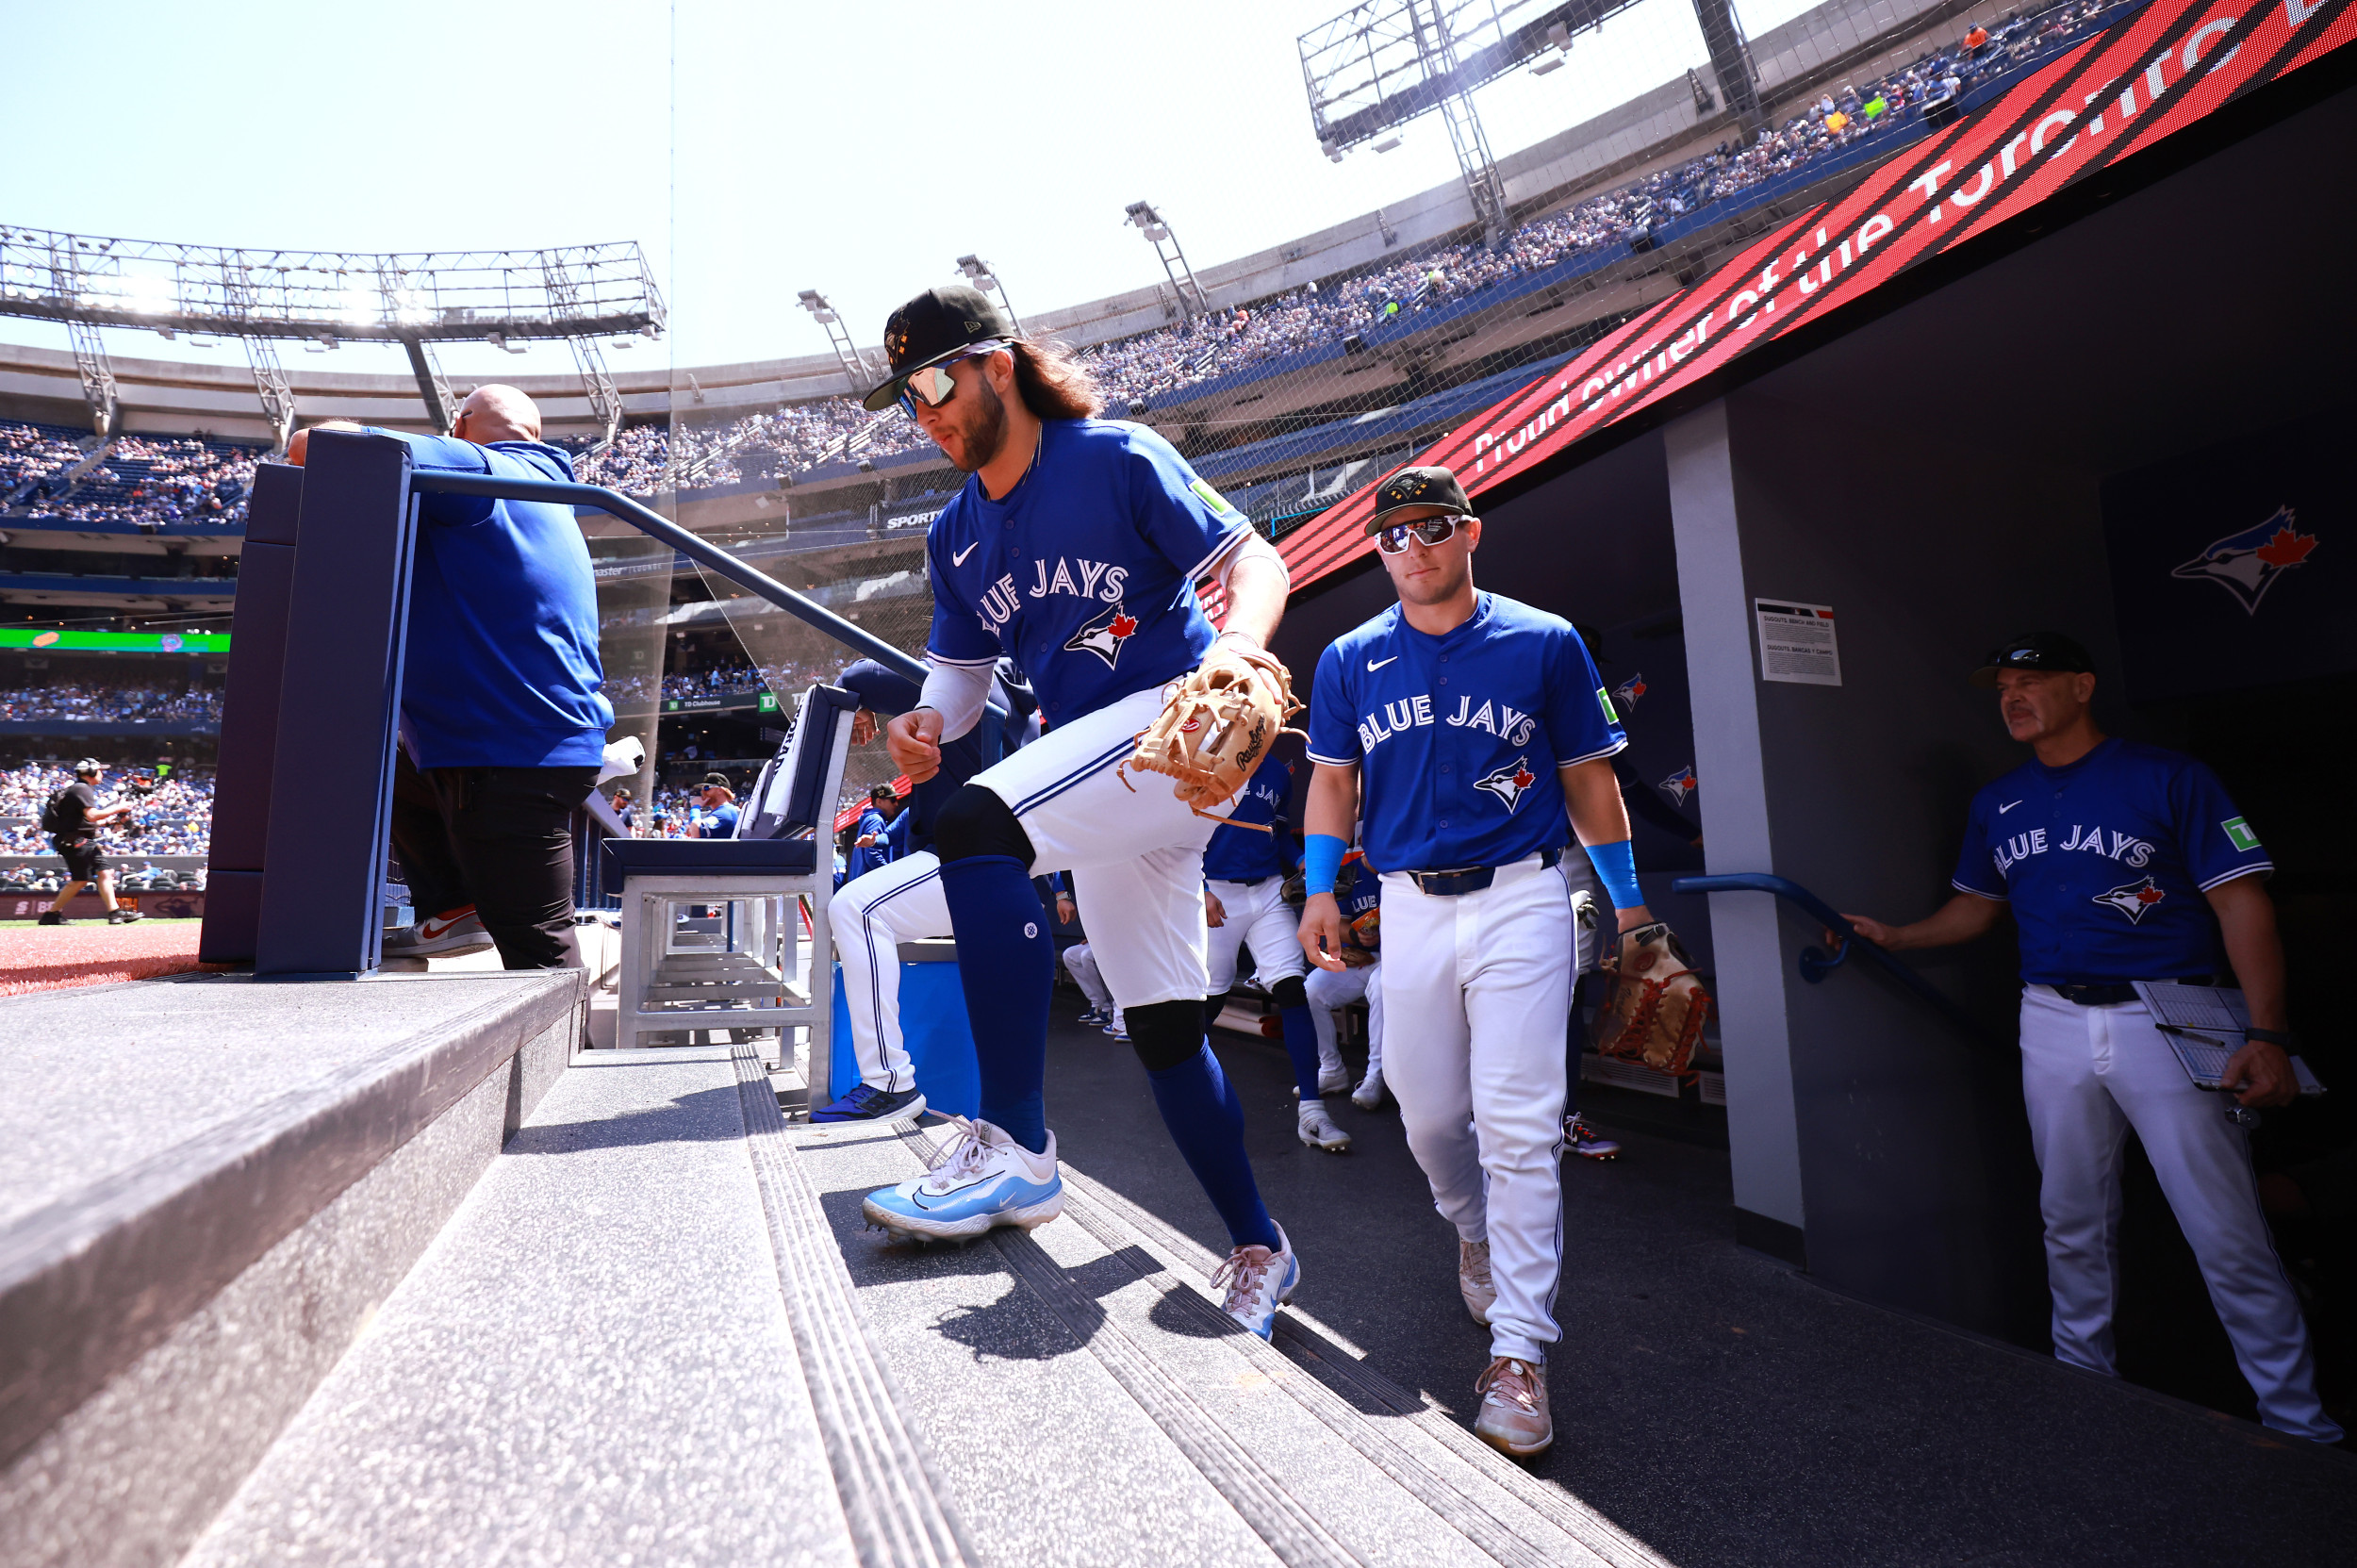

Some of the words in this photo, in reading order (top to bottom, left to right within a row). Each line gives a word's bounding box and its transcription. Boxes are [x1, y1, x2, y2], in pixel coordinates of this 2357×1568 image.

[1475, 380, 1571, 472] Proud
[1582, 312, 1714, 412] owner
[1729, 257, 1780, 330] of
[1793, 214, 1894, 294] the
[1908, 16, 2242, 224] Toronto
[977, 572, 1021, 641] LUE
[1030, 556, 1129, 602] JAYS
[761, 695, 776, 708] TD
[1358, 694, 1436, 755] BLUE
[1445, 695, 1537, 747] JAYS
[1256, 784, 1281, 809] JAY
[2060, 824, 2156, 868] JAYS
[2231, 822, 2257, 841] T
[1351, 895, 1377, 913] LUE
